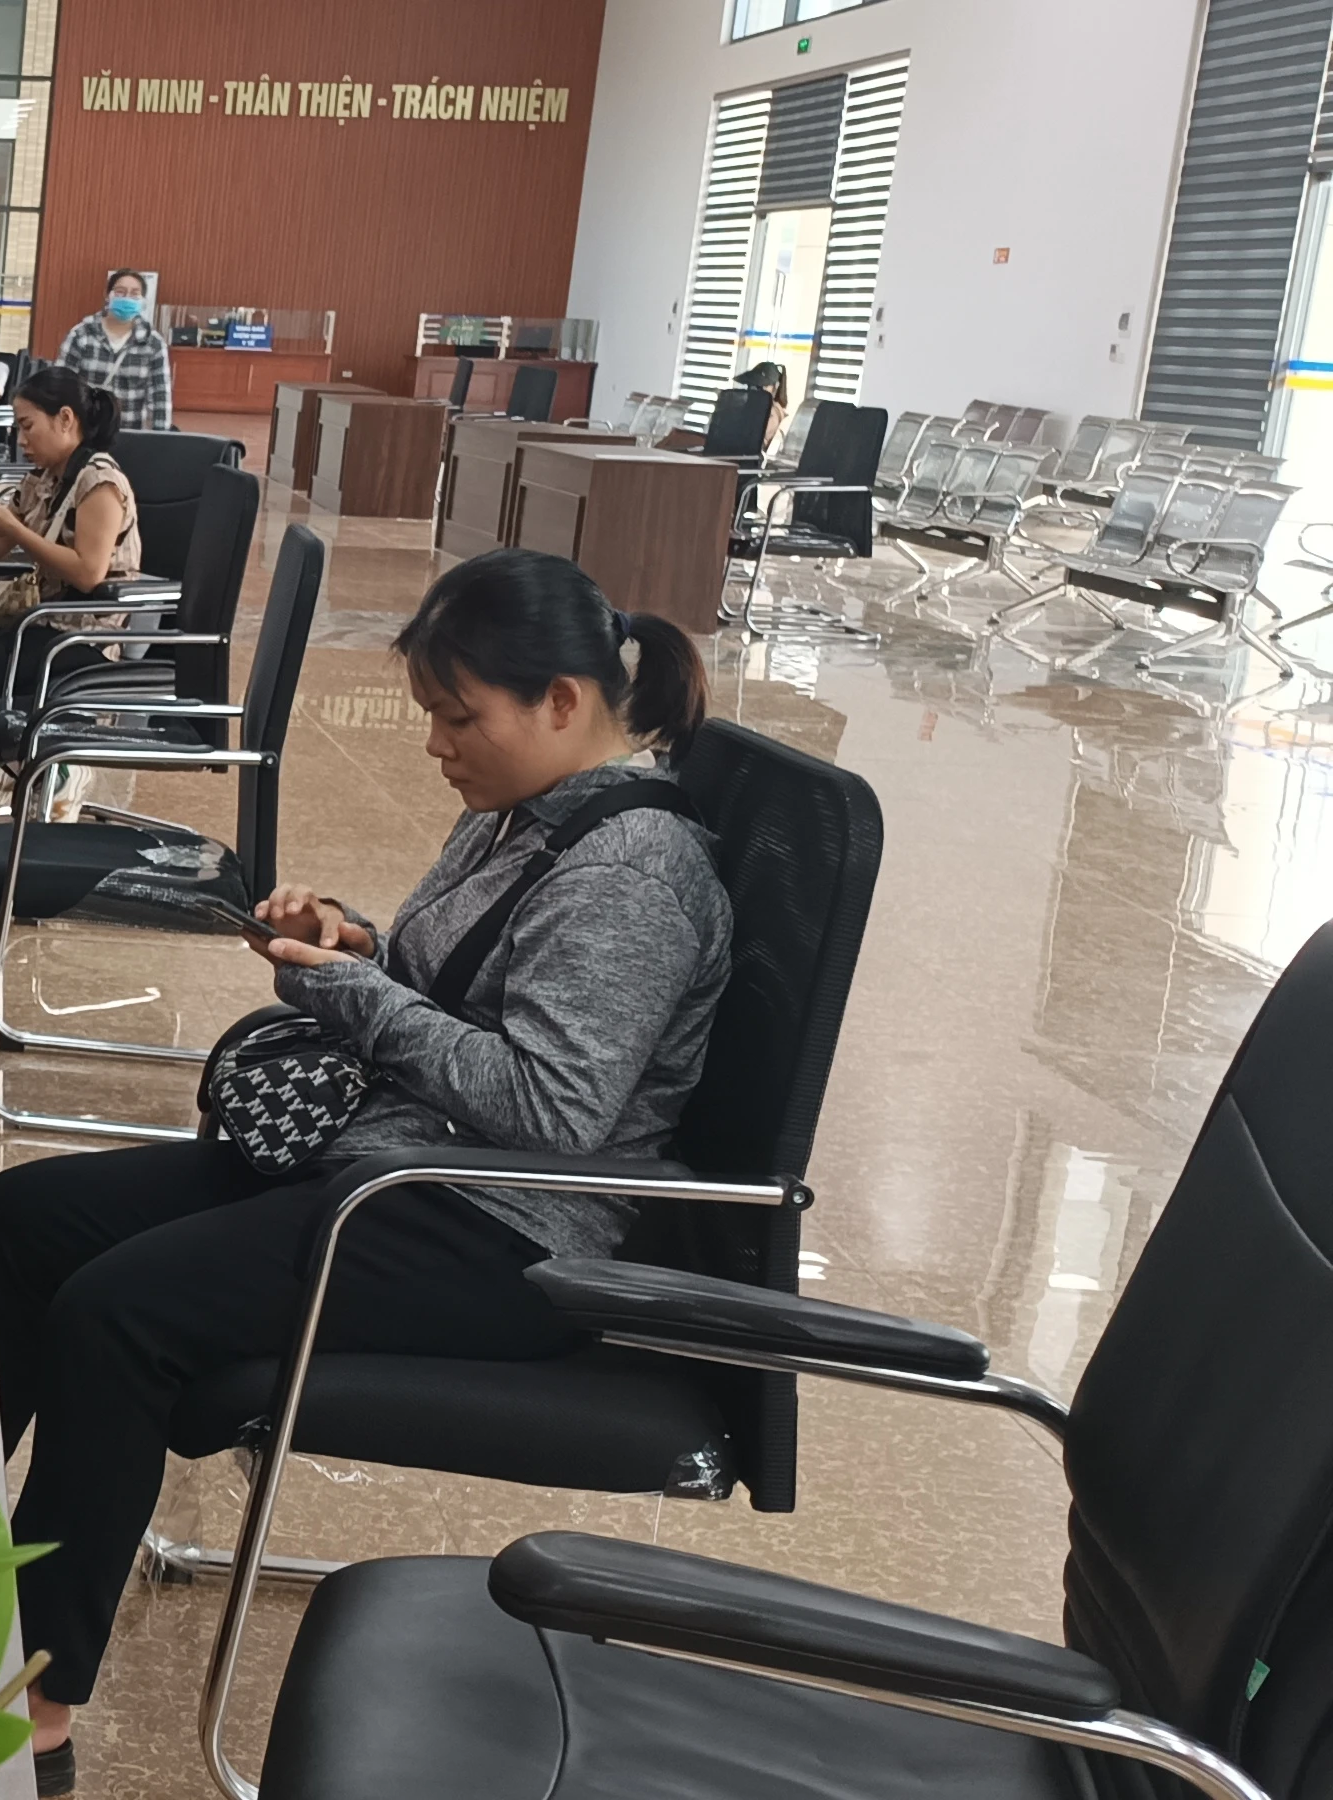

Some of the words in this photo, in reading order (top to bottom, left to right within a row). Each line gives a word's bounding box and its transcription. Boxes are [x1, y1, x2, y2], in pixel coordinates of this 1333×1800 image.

[82, 68, 131, 112] VĂN
[136, 78, 204, 114] MINH
[223, 73, 291, 117] THÂN
[298, 74, 373, 126] THIỆN
[391, 75, 475, 121] TRÁCH
[479, 78, 570, 131] NHIỆM
[220, 1081, 245, 1110] NY
[246, 1067, 275, 1096] NY
[245, 1097, 274, 1127] NY
[276, 1082, 306, 1112] NY
[243, 1128, 272, 1158] NY
[275, 1114, 303, 1144] NY
